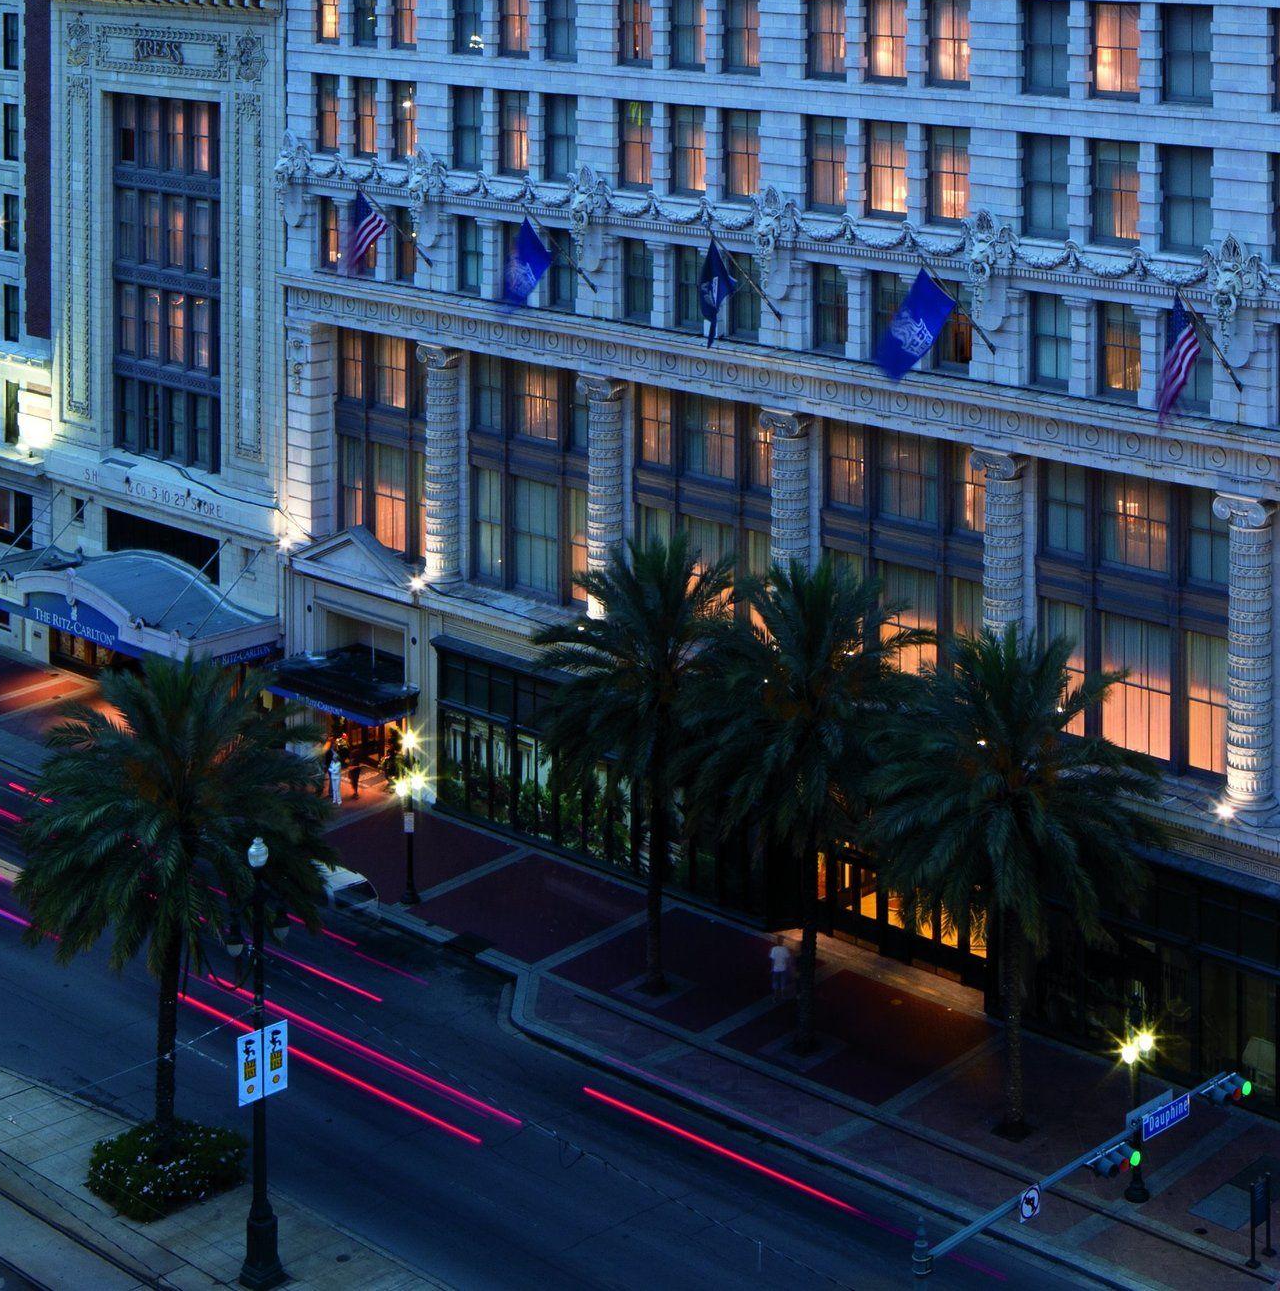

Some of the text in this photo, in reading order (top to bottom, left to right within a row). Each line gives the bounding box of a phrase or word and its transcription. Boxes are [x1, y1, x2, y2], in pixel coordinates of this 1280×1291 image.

[133, 38, 183, 65] KRESS
[33, 607, 52, 623] THE
[1149, 1101, 1189, 1132] Dauphine
